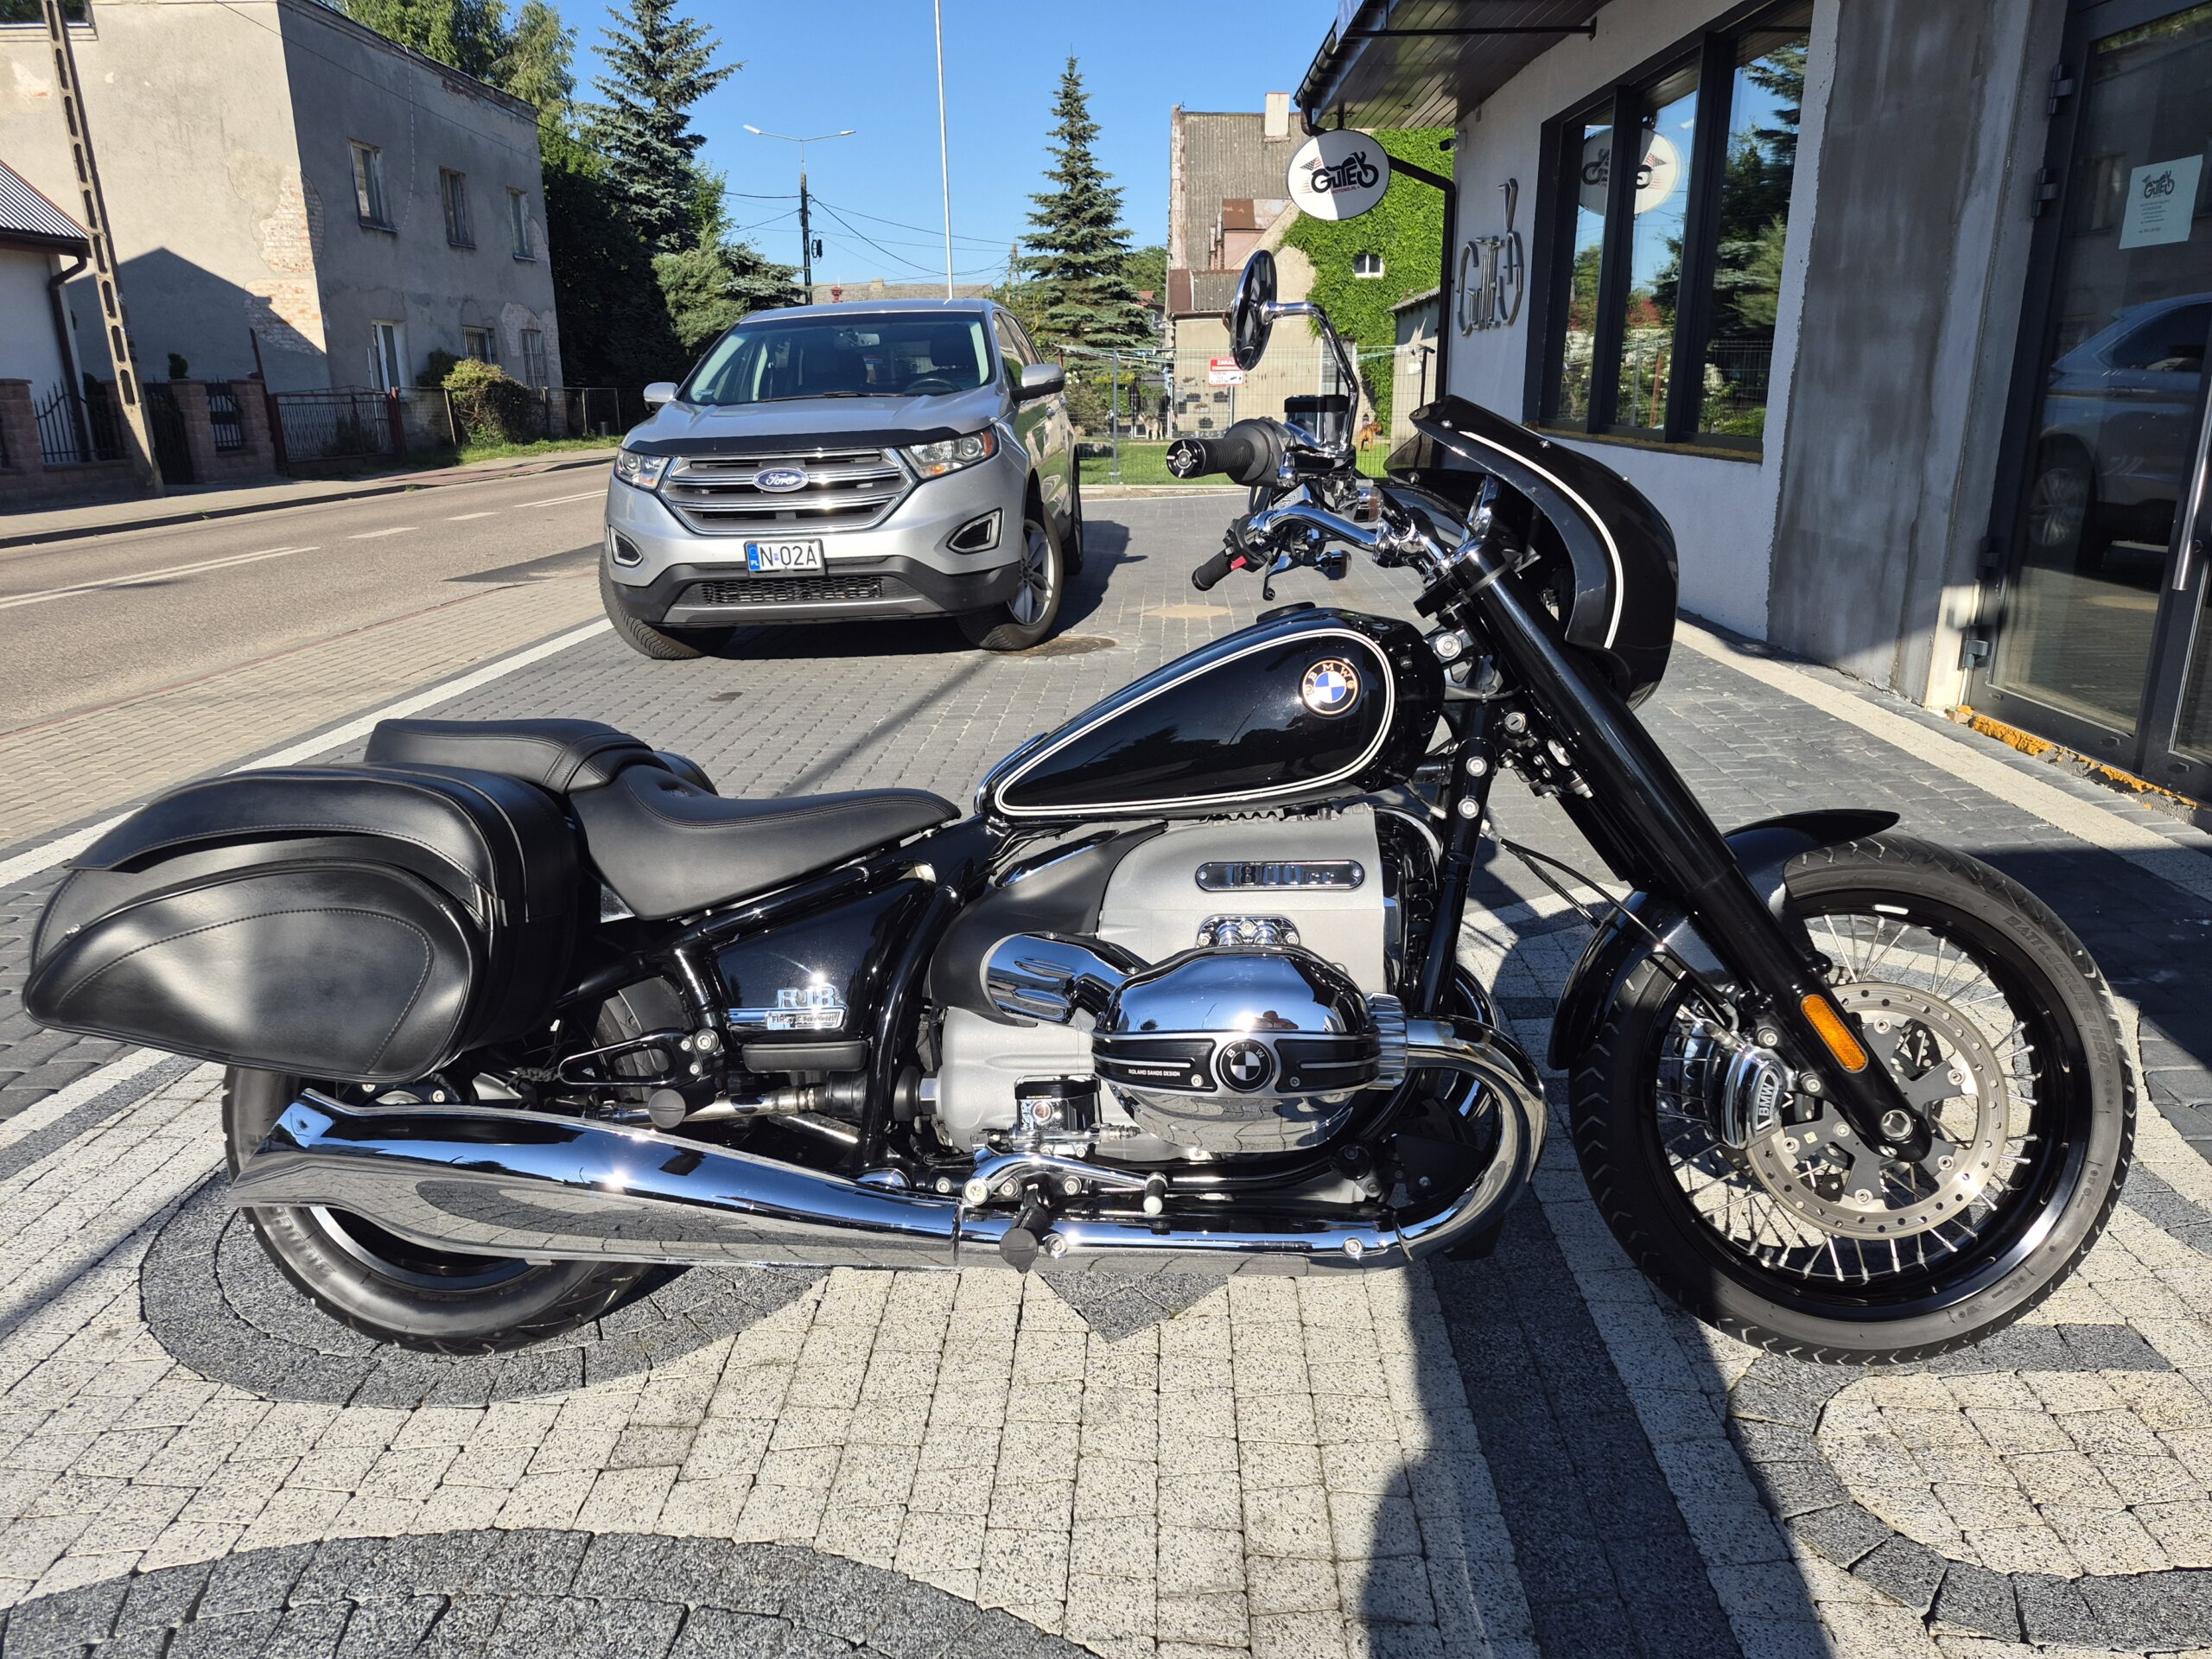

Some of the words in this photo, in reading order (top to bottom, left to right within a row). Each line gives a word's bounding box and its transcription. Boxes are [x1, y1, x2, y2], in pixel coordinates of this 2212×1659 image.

[766, 473, 798, 486] Ford
[1308, 663, 1351, 682] BMW
[1225, 865, 1303, 885] 1800
[1225, 1042, 1266, 1059] BMW
[1758, 1082, 1775, 1117] BMW
